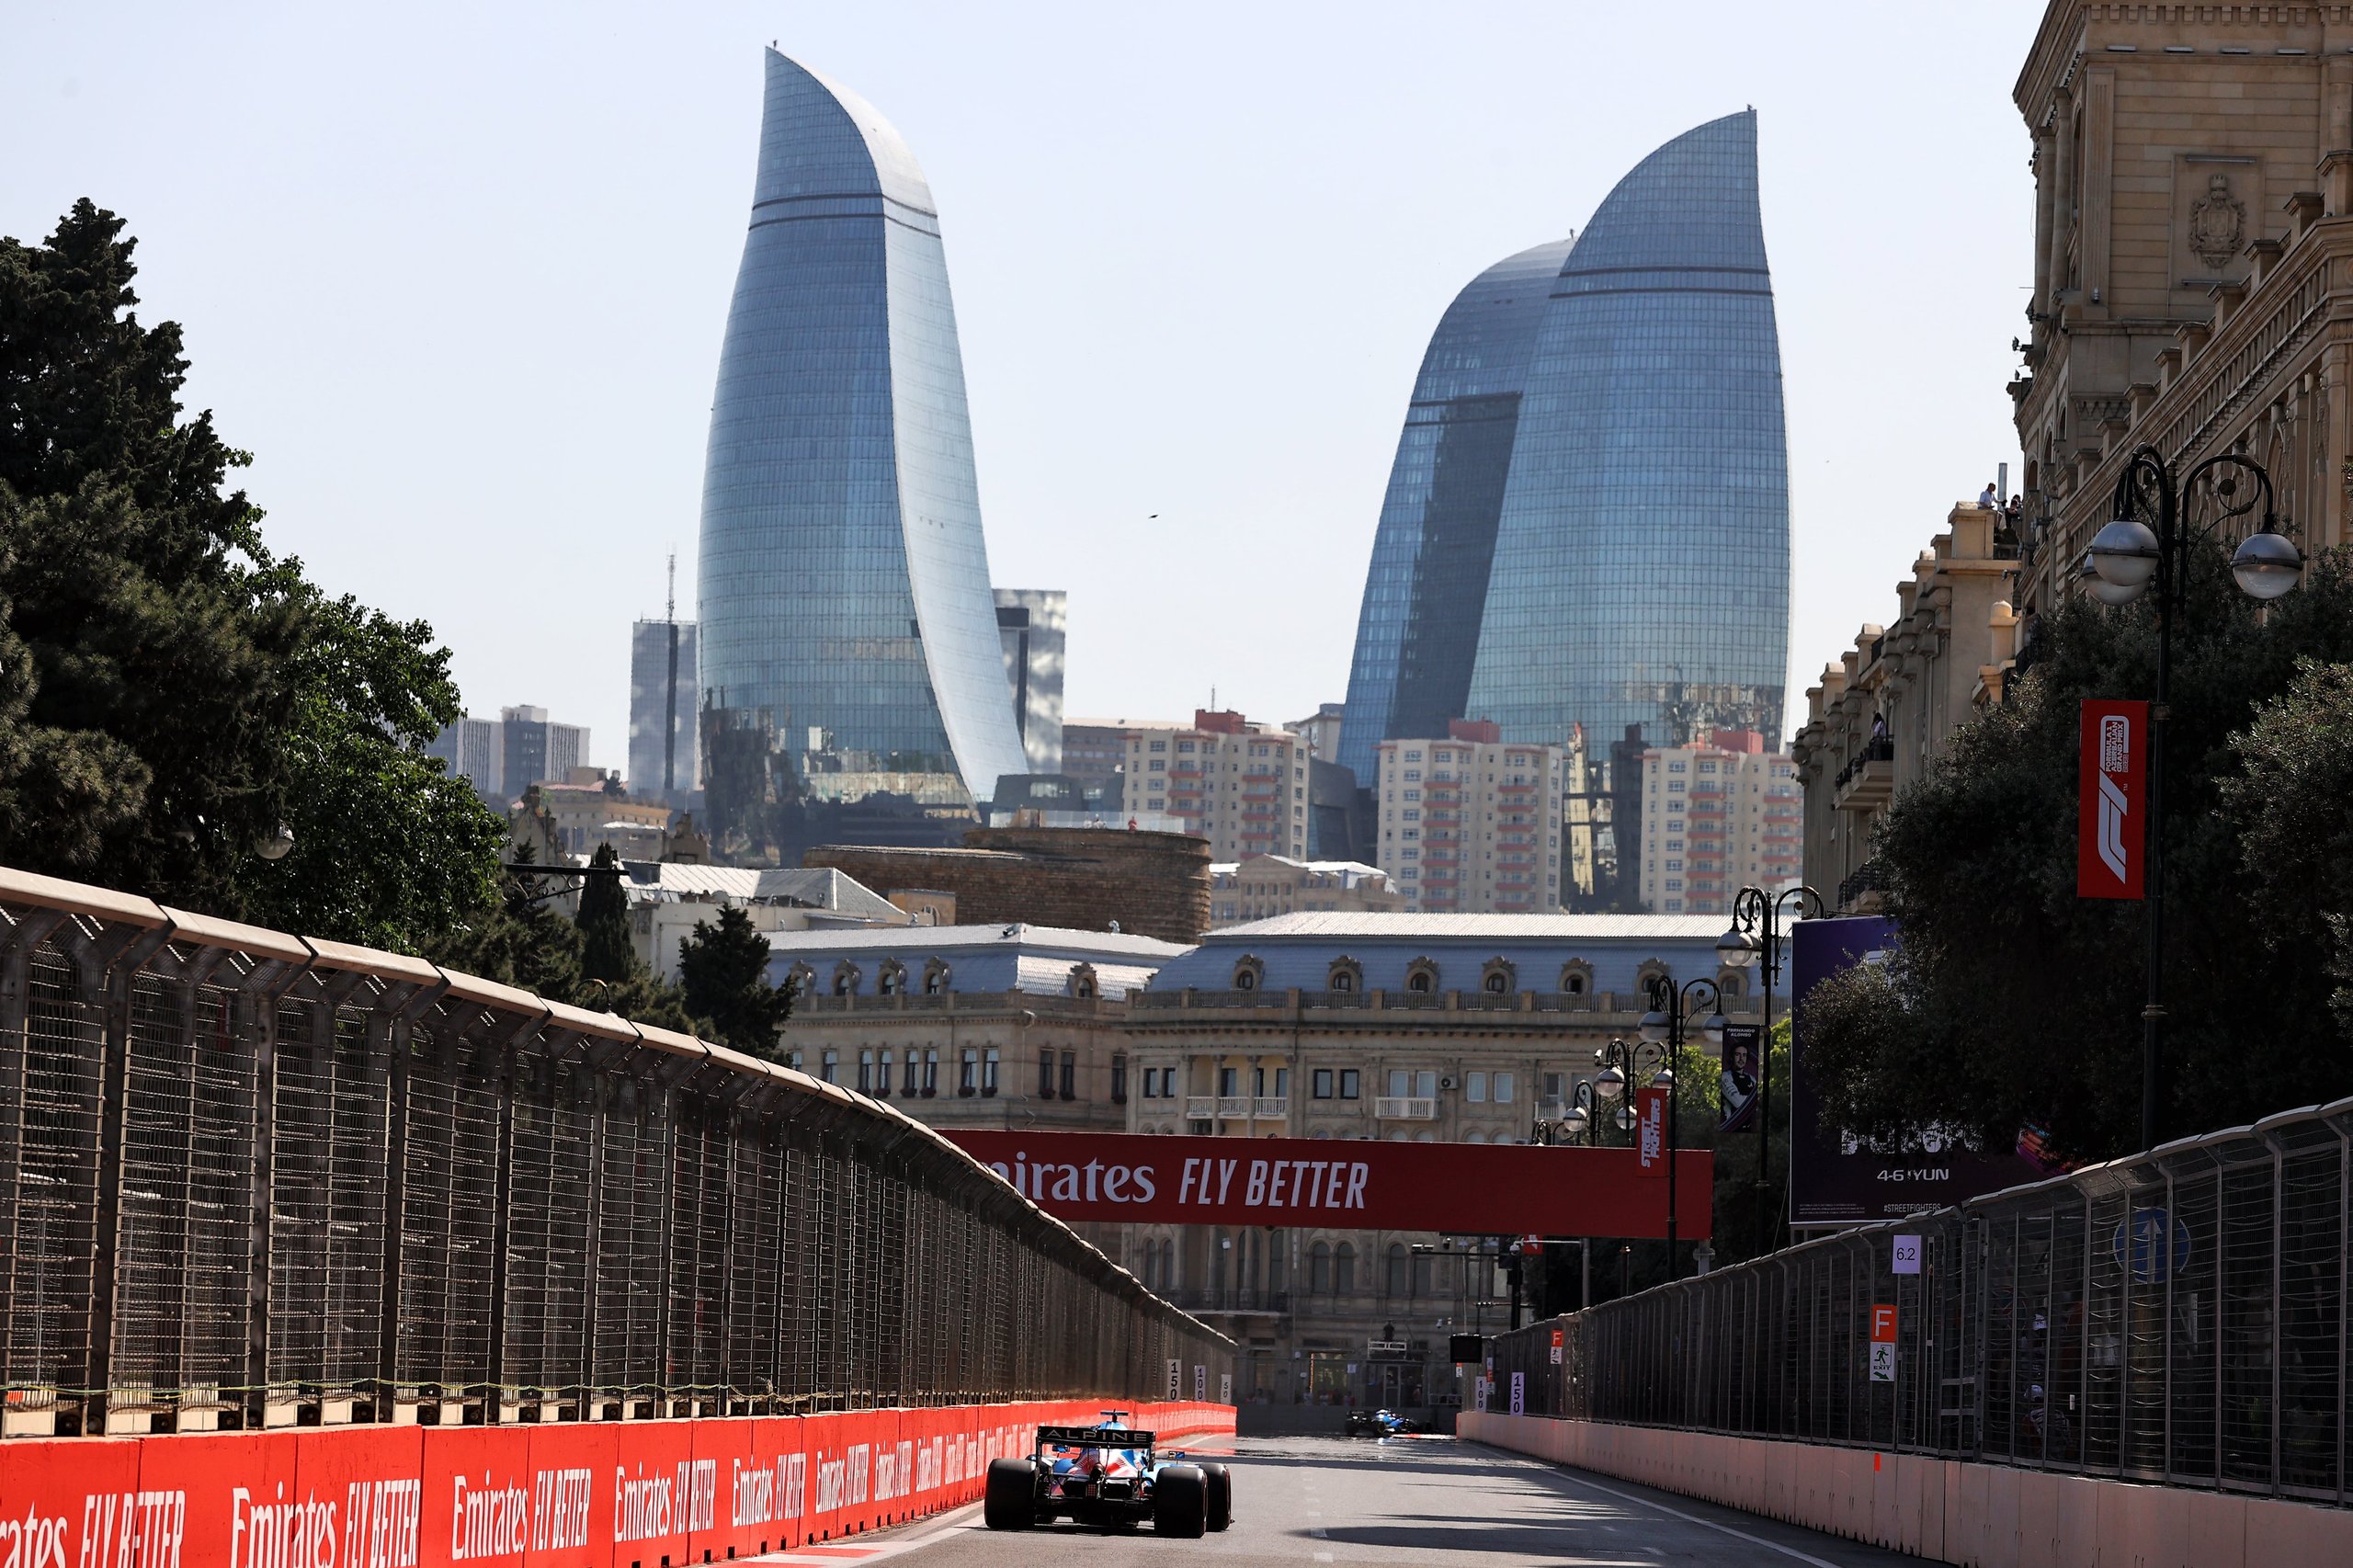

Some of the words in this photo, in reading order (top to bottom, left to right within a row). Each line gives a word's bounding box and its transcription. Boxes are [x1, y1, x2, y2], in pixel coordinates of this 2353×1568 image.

[1641, 1118, 1651, 1167] STREET
[981, 1152, 1155, 1203] irates
[1178, 1158, 1237, 1206] FLY
[1245, 1160, 1369, 1209] BETTER
[1876, 1169, 1904, 1181] 4-6
[1896, 1247, 1915, 1261] 6.2
[1553, 1333, 1561, 1345] F
[1875, 1310, 1892, 1336] F
[1170, 1361, 1178, 1402] 150
[1223, 1381, 1229, 1398] 50
[1513, 1375, 1521, 1414] 150
[1045, 1428, 1147, 1442] ALPINE
[614, 1461, 672, 1542] Emirates
[673, 1461, 691, 1534] FLY
[688, 1459, 716, 1532] BETTER
[732, 1454, 774, 1527] Emirates
[0, 1502, 68, 1568] ates
[118, 1490, 186, 1568] BETTER
[231, 1481, 336, 1568] Emirates
[345, 1482, 369, 1568] FLY
[369, 1478, 421, 1568] BETTER
[451, 1470, 529, 1561] Emirates
[531, 1471, 554, 1551] FLY
[551, 1468, 592, 1550] BETTER
